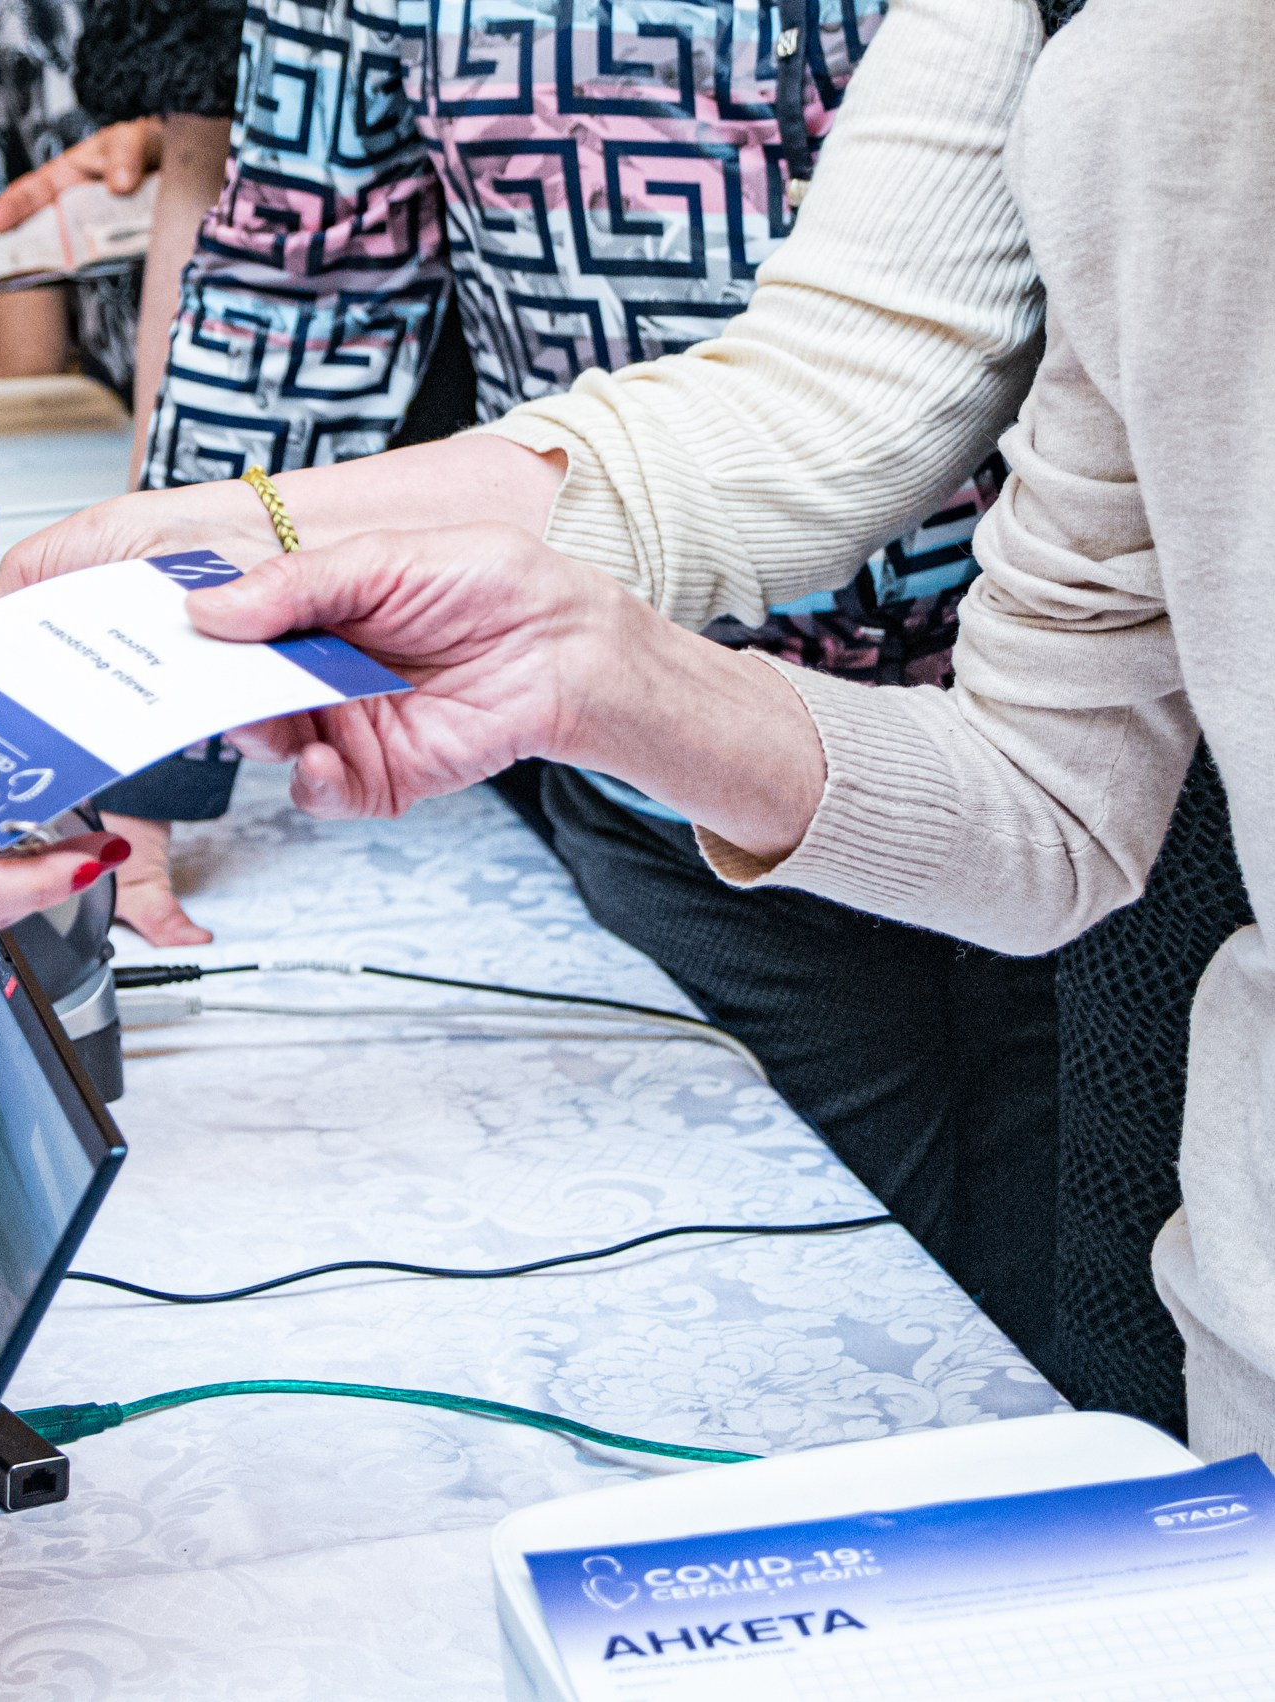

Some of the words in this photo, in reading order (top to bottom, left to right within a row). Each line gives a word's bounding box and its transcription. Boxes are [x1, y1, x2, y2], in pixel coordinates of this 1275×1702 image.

[1153, 1502, 1249, 1527] STADA
[643, 1547, 876, 1588] COVID-19:
[650, 1577, 771, 1601] СЕРДЦЕ
[801, 1564, 883, 1586] БОЛЬ
[603, 1607, 868, 1662] АНКЕТА
